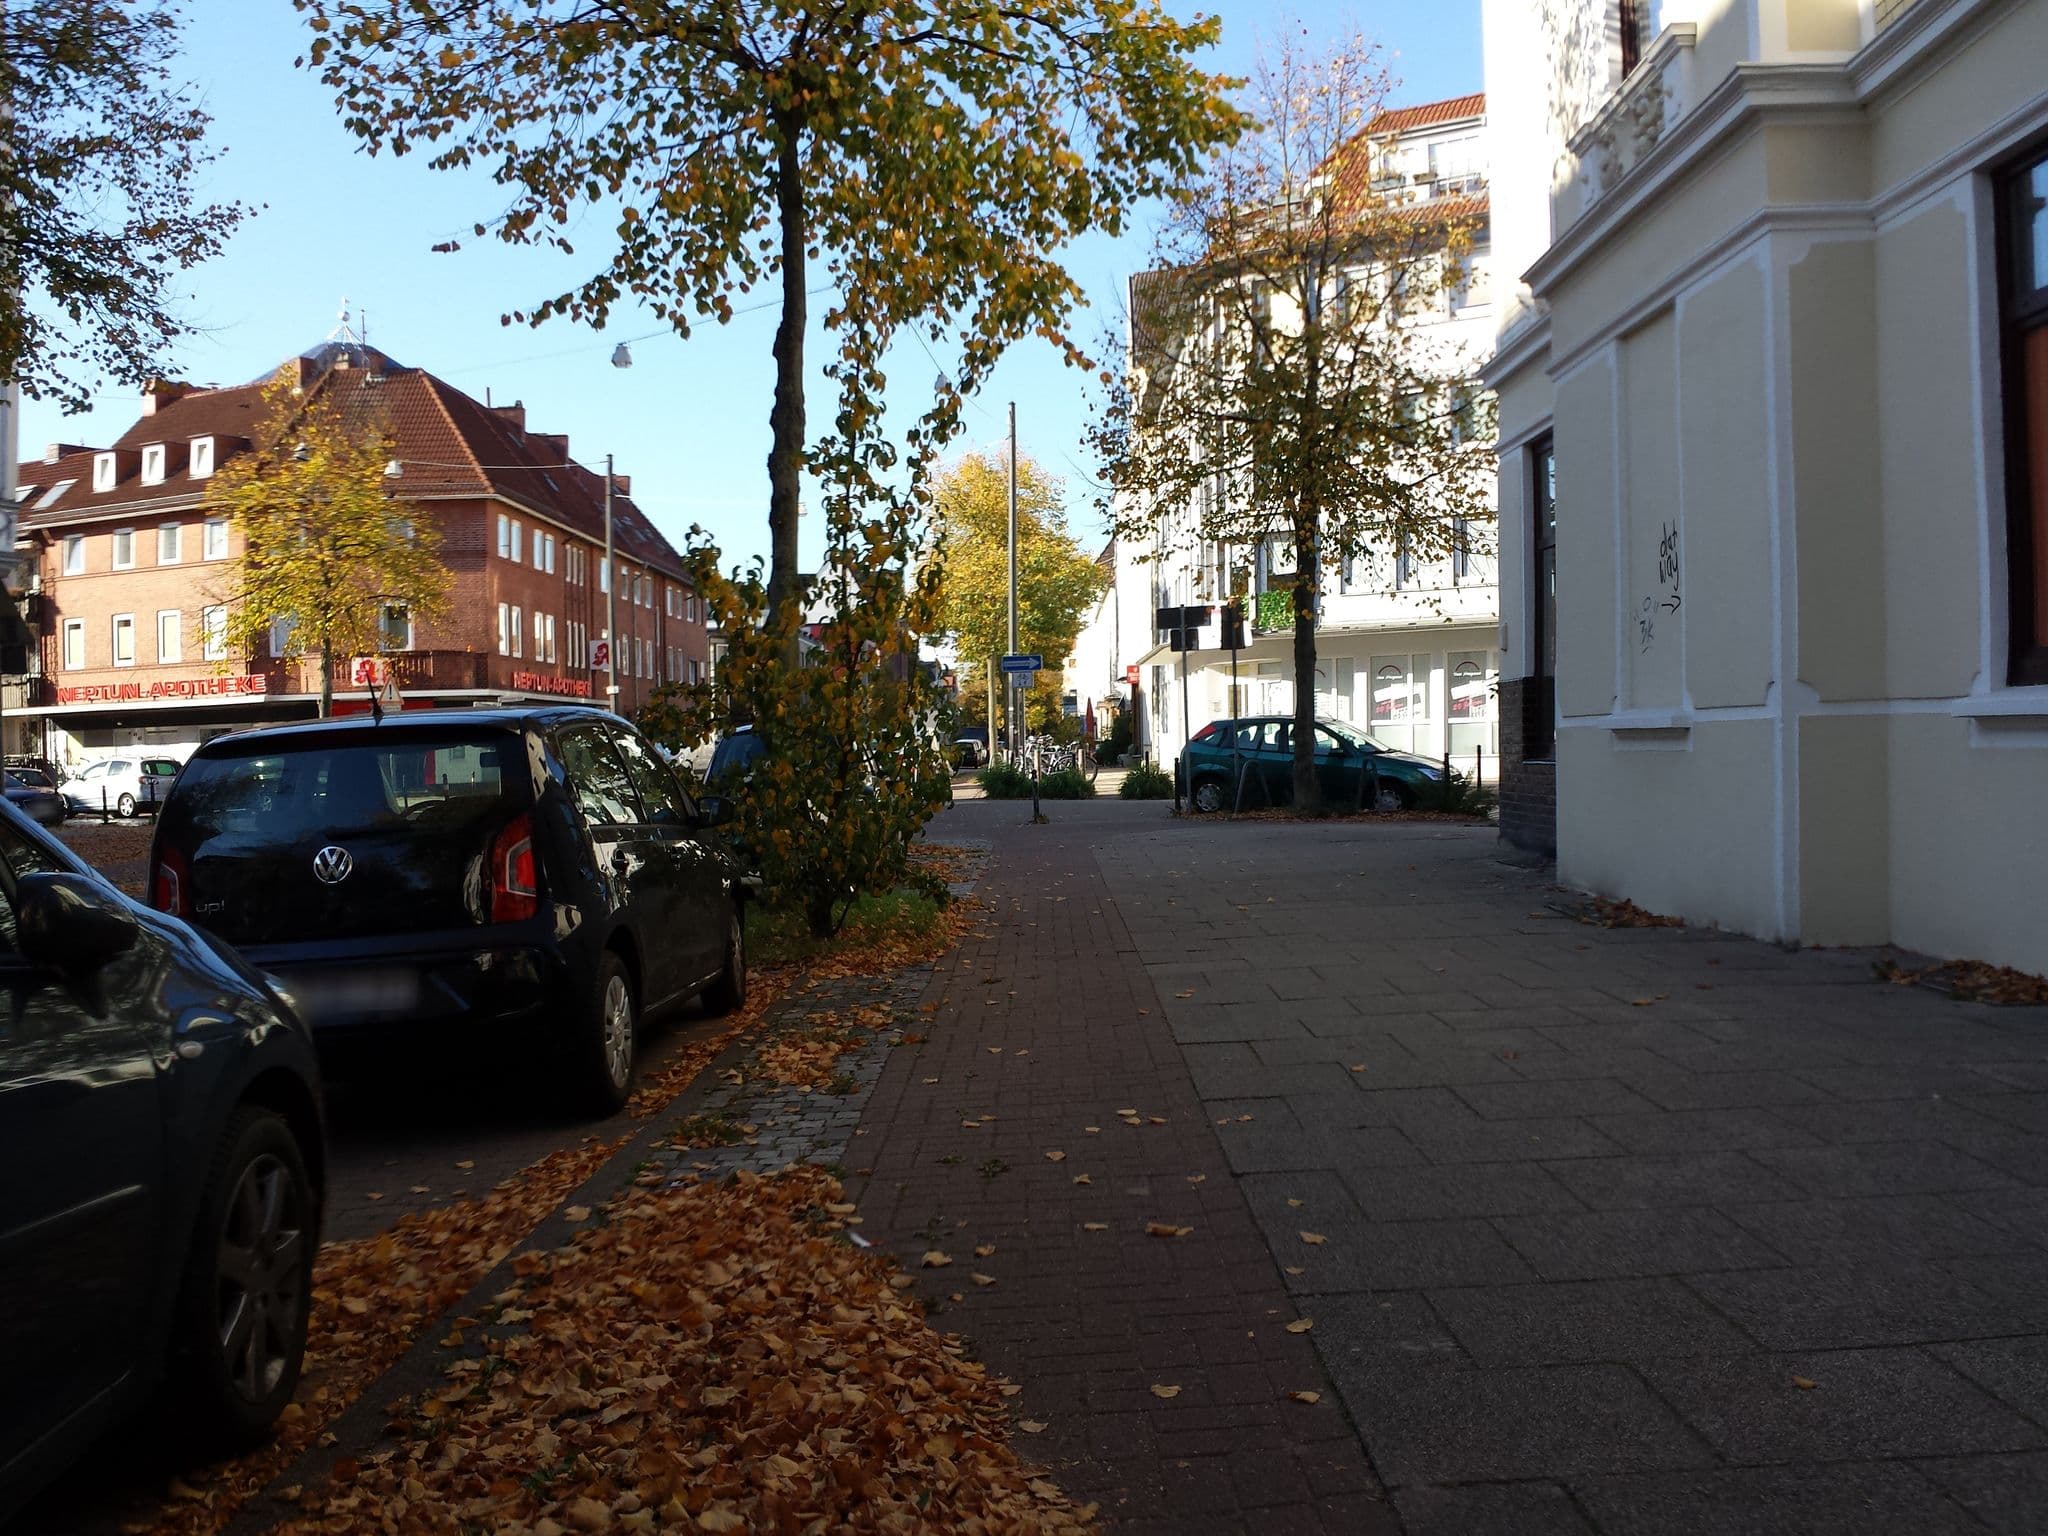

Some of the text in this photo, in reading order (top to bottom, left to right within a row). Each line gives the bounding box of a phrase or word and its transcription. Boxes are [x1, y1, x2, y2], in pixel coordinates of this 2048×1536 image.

[1660, 519, 1678, 558] dat
[1659, 552, 1680, 592] way
[57, 673, 267, 703] NEPTUN-APOTHEKE
[195, 899, 225, 915] up!
